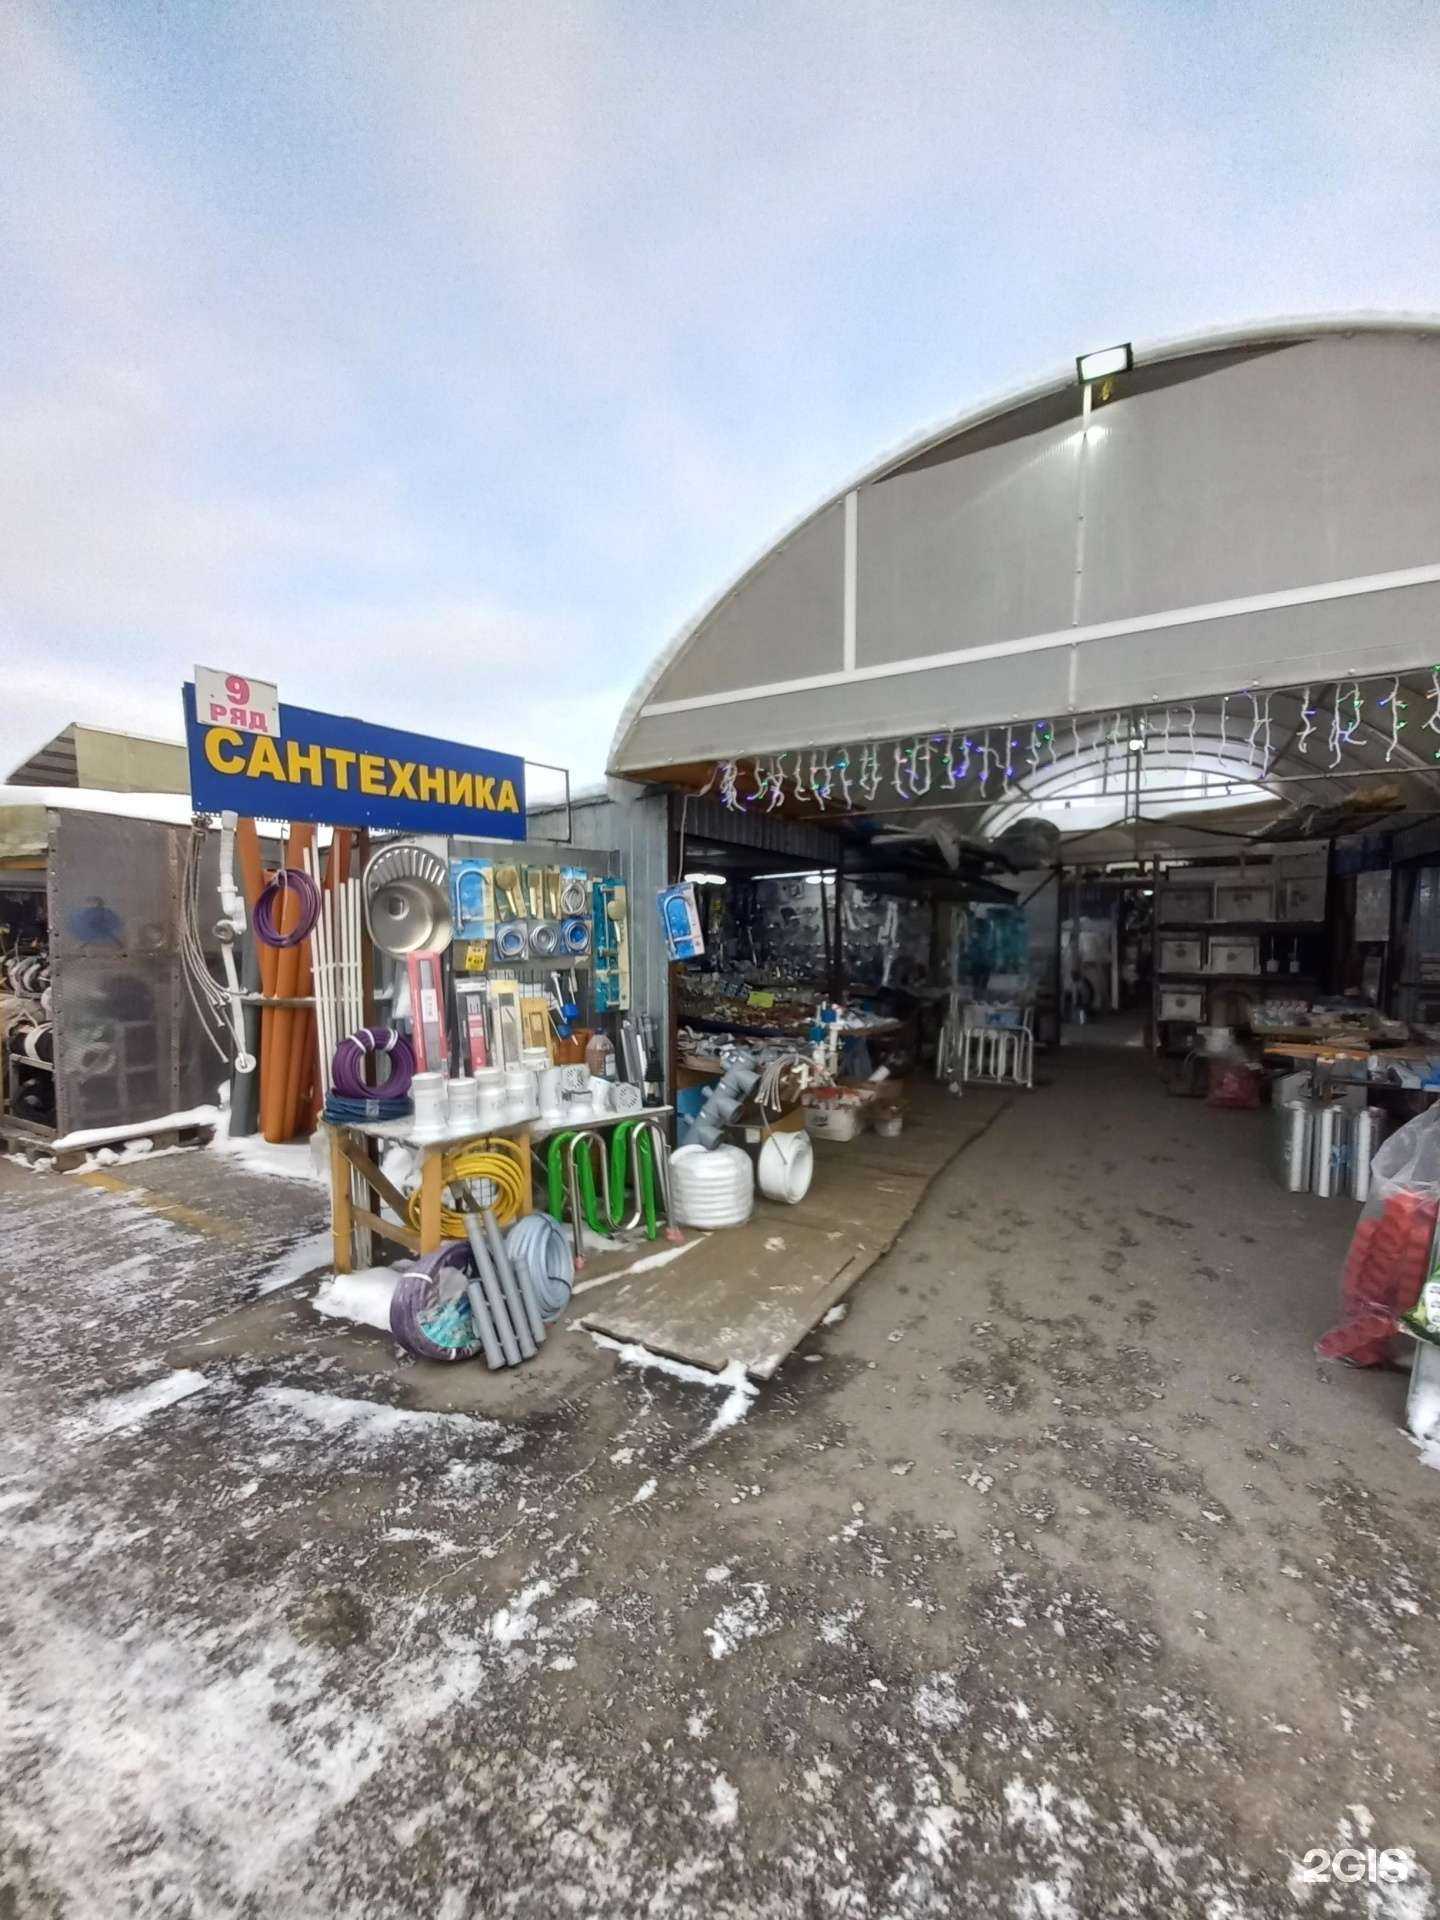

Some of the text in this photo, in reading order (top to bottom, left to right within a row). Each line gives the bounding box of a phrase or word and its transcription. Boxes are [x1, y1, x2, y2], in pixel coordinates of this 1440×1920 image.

[224, 674, 251, 706] 9
[209, 703, 268, 733] РЯД
[203, 726, 520, 814] САНТЕХНИКА
